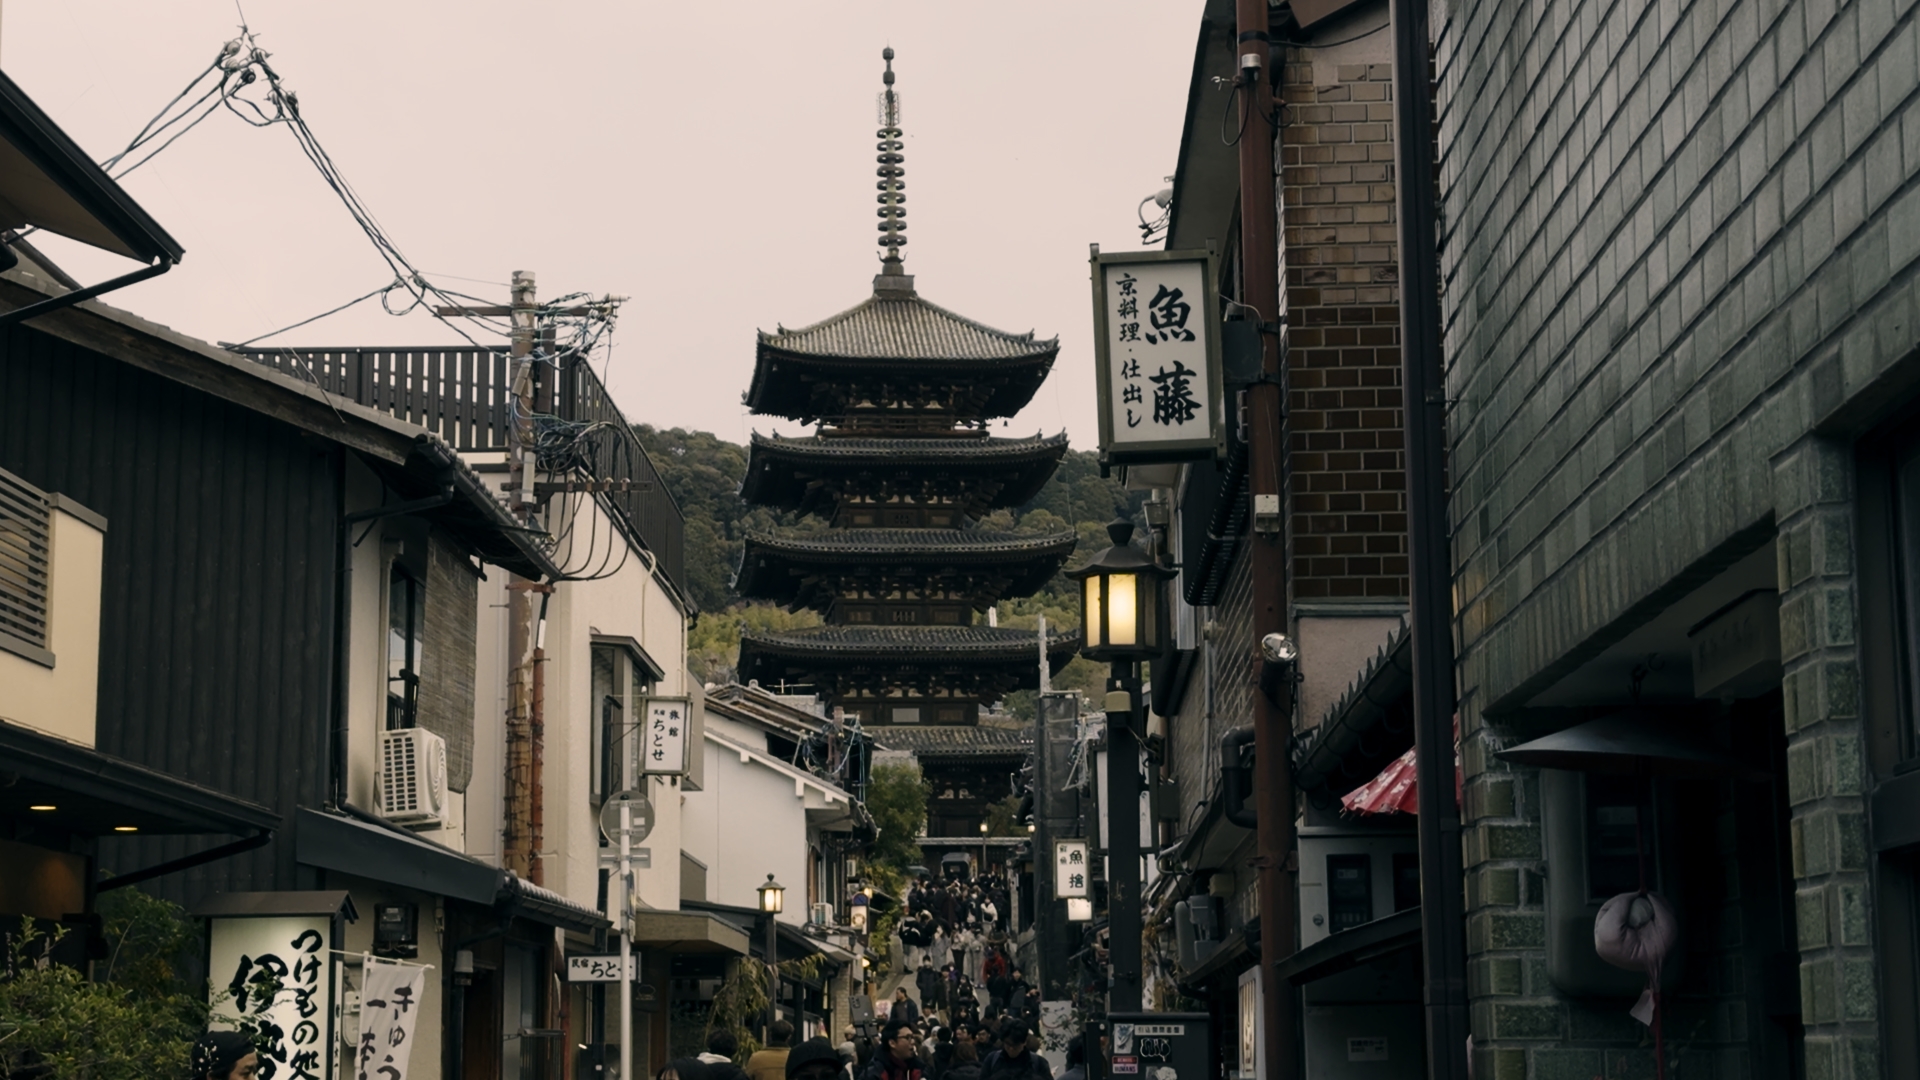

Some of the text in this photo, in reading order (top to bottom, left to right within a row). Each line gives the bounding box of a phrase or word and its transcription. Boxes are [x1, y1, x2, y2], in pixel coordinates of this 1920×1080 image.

[1115, 272, 1143, 429] 京料理・仕出し
[1144, 283, 1203, 427] 魚藤
[651, 718, 666, 762] ちとせ
[668, 708, 680, 738] 旅館
[290, 928, 323, 1080] つけもの処
[590, 960, 633, 979] ちと
